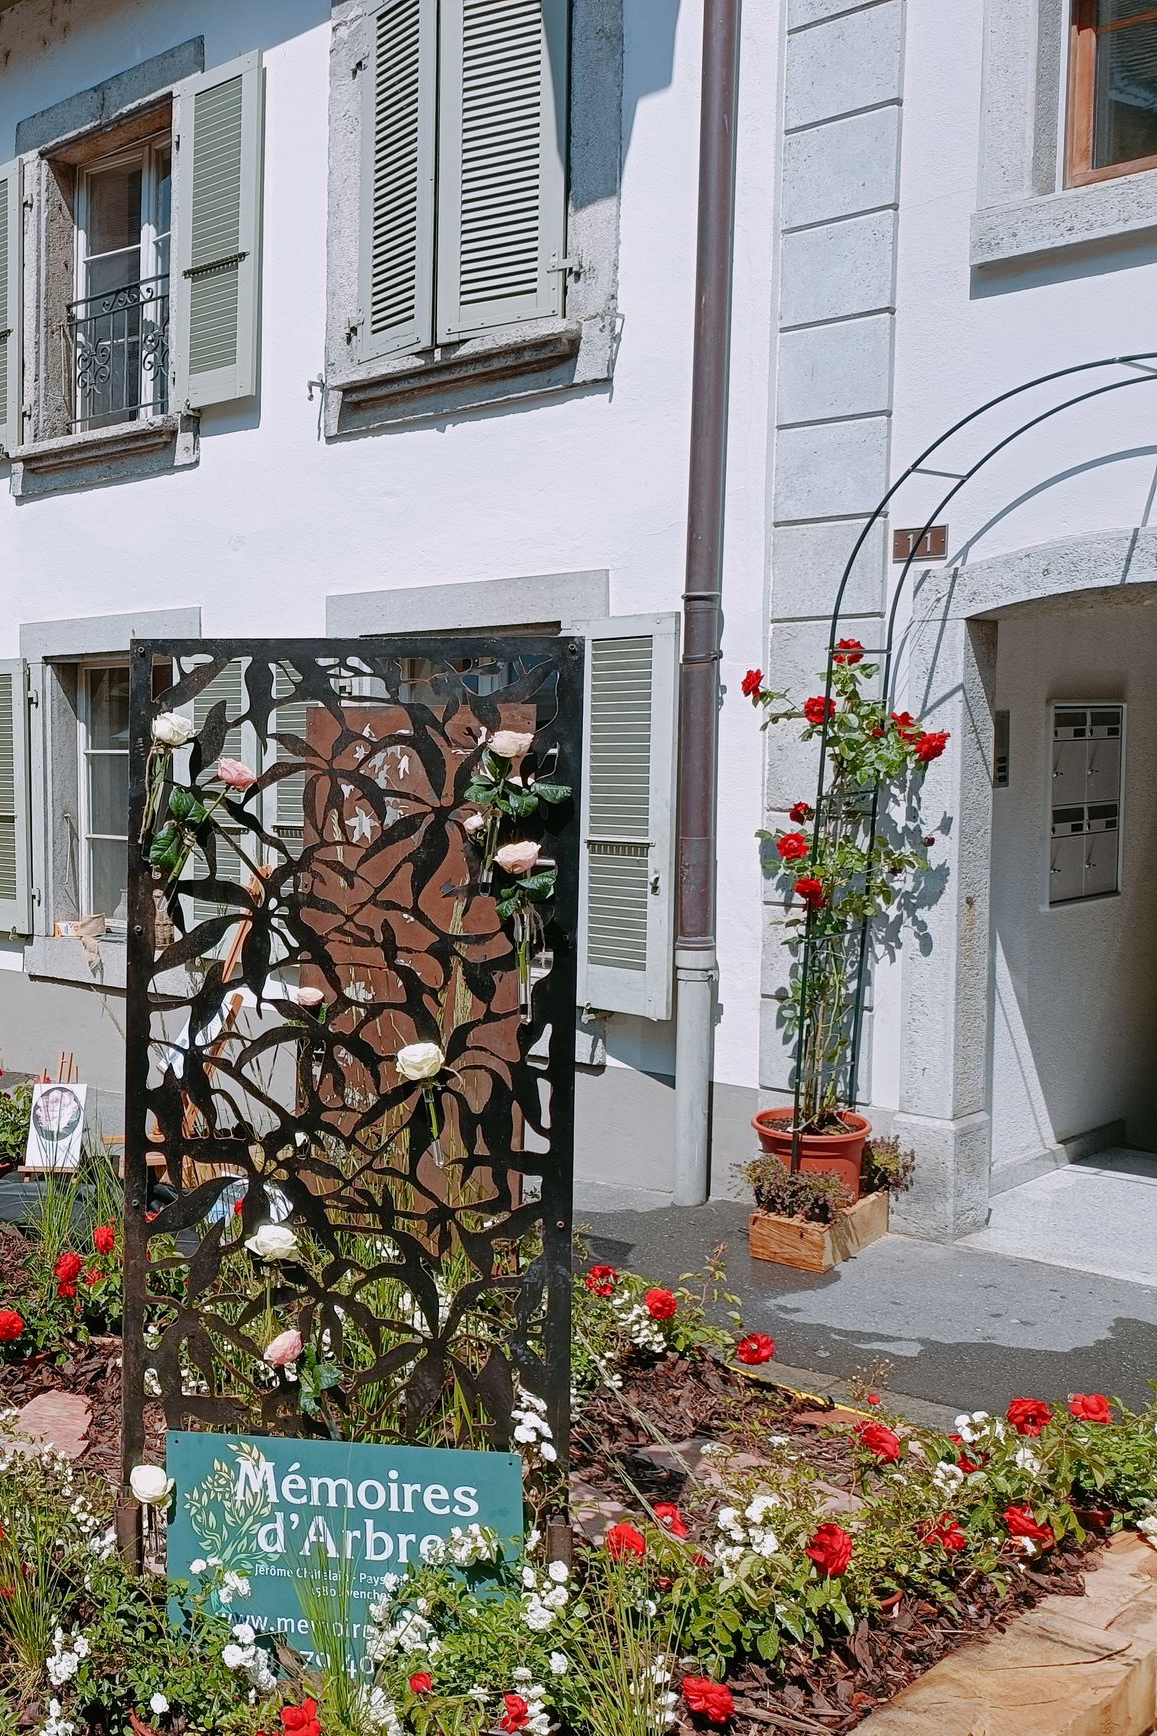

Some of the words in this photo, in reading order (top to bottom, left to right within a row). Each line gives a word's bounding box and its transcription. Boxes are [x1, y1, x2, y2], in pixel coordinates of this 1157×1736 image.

[907, 532, 931, 554] 11
[234, 1456, 480, 1517] Mémoires
[257, 1511, 448, 1565] d'Arbre
